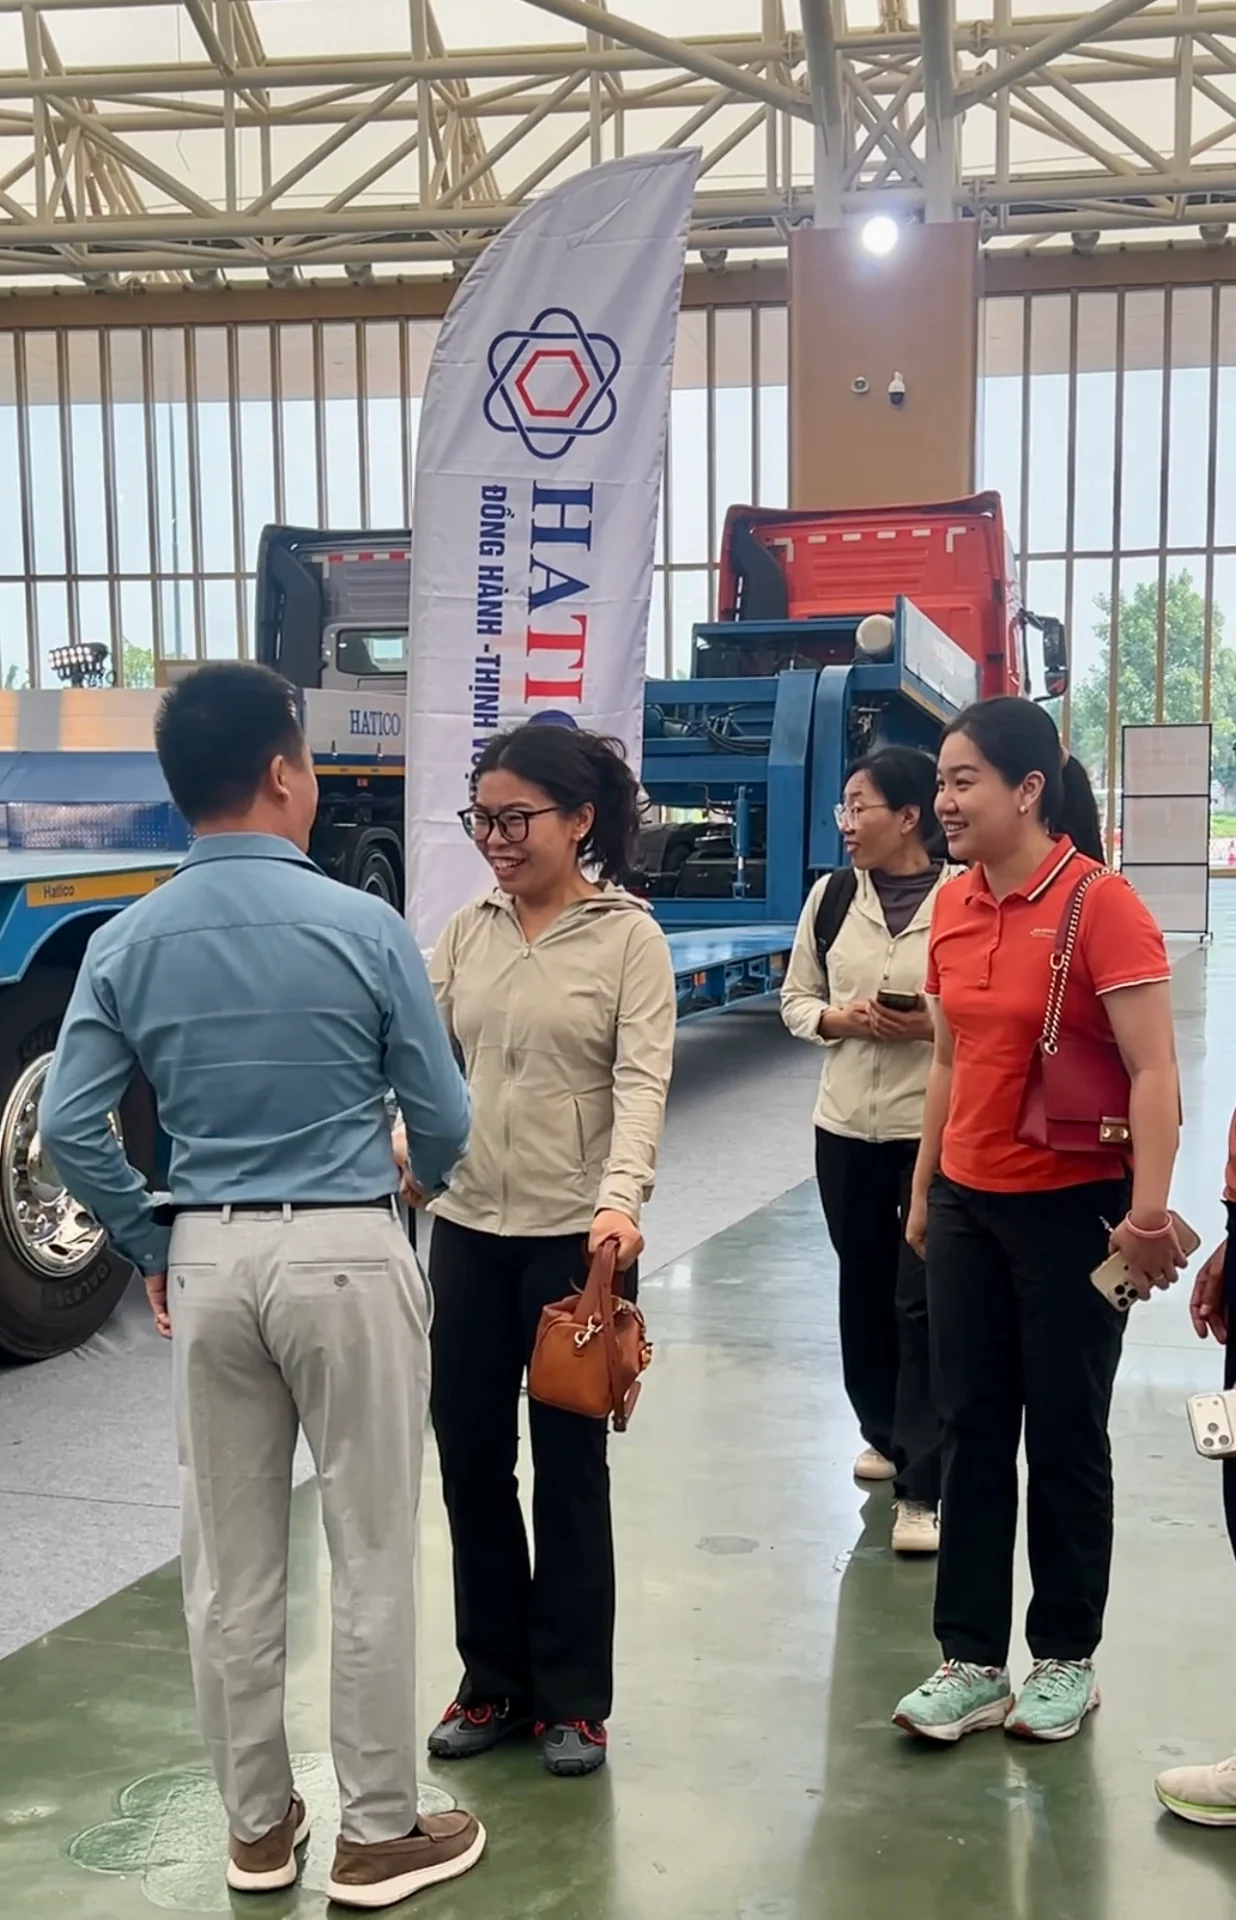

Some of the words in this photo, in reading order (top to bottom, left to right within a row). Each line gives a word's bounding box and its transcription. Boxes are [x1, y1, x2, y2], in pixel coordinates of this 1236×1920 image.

[479, 485, 514, 556] ĐỒNG
[476, 564, 510, 635] HÀNH
[349, 709, 401, 737] HATICO
